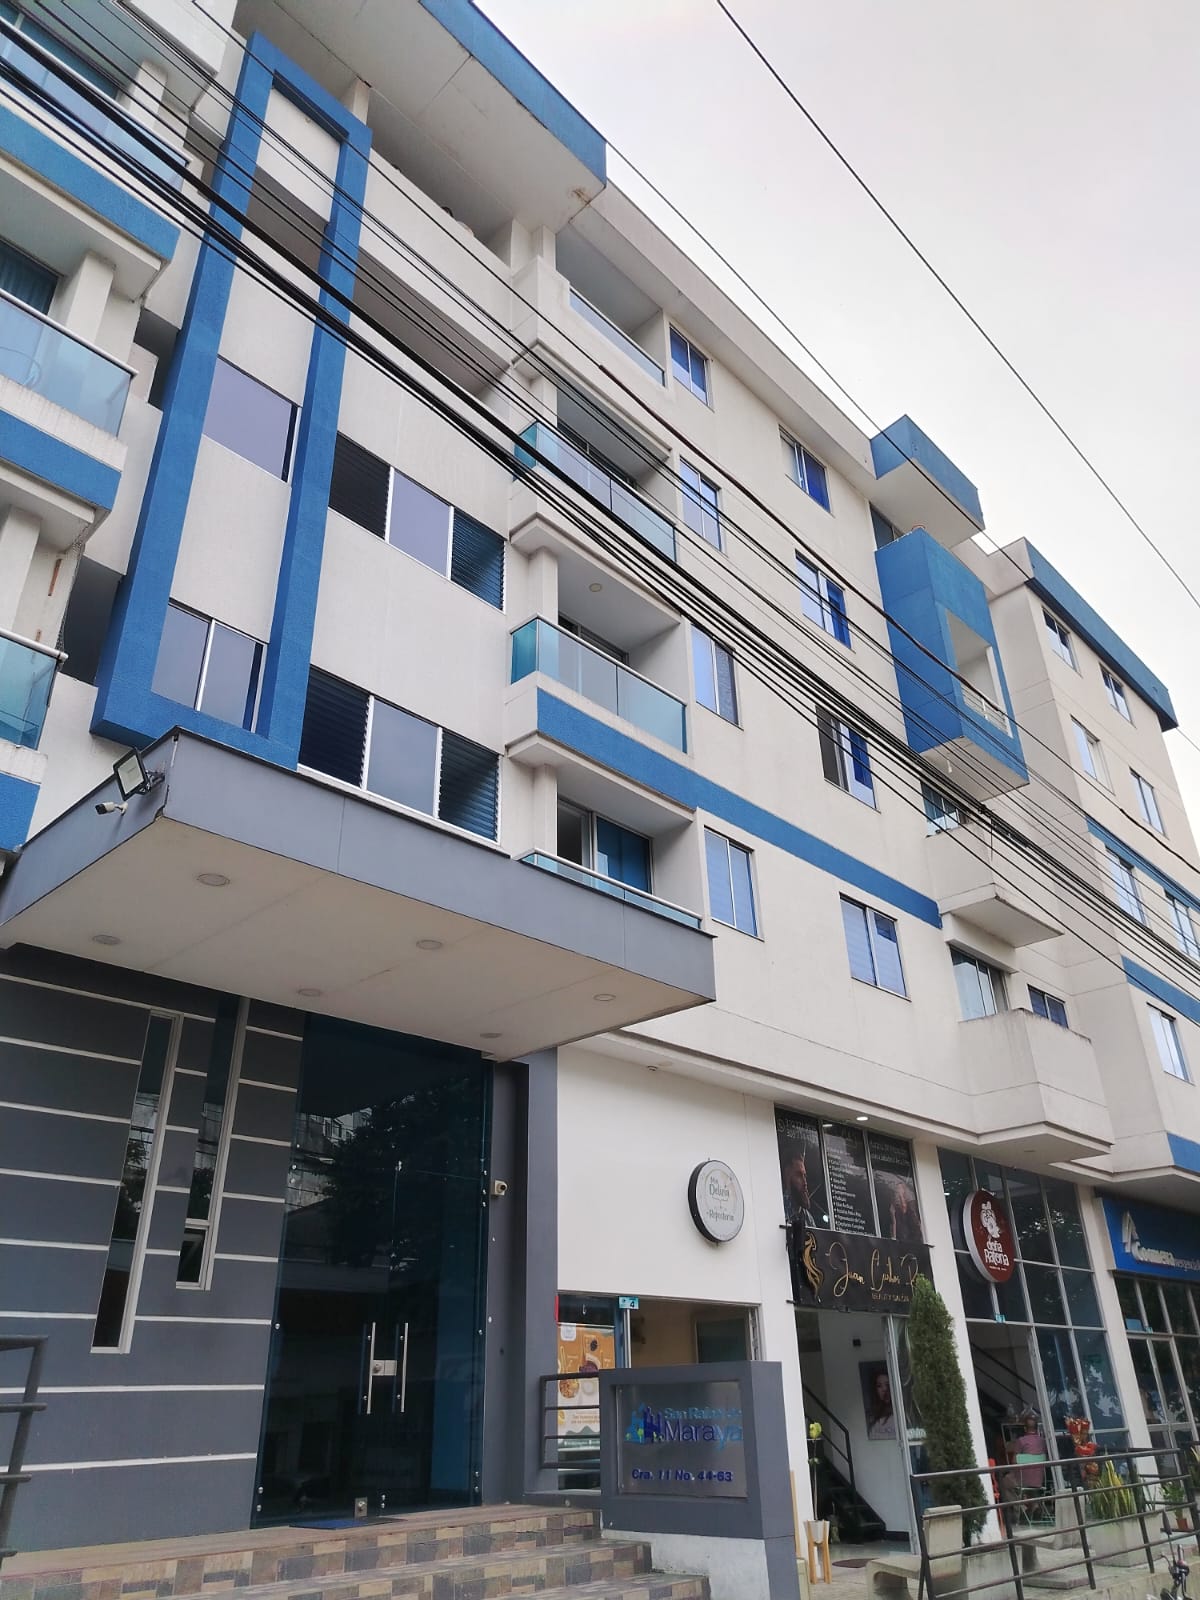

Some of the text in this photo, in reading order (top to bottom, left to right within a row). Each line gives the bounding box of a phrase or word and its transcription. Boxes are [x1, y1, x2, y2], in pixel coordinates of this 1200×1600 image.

[825, 1241, 919, 1299] Juan Carlos R
[983, 1248, 1010, 1267] Ratona
[664, 1418, 744, 1451] Maraya
[631, 1468, 654, 1481] Cra.
[675, 1469, 696, 1482] No.
[697, 1469, 734, 1483] 44-63
